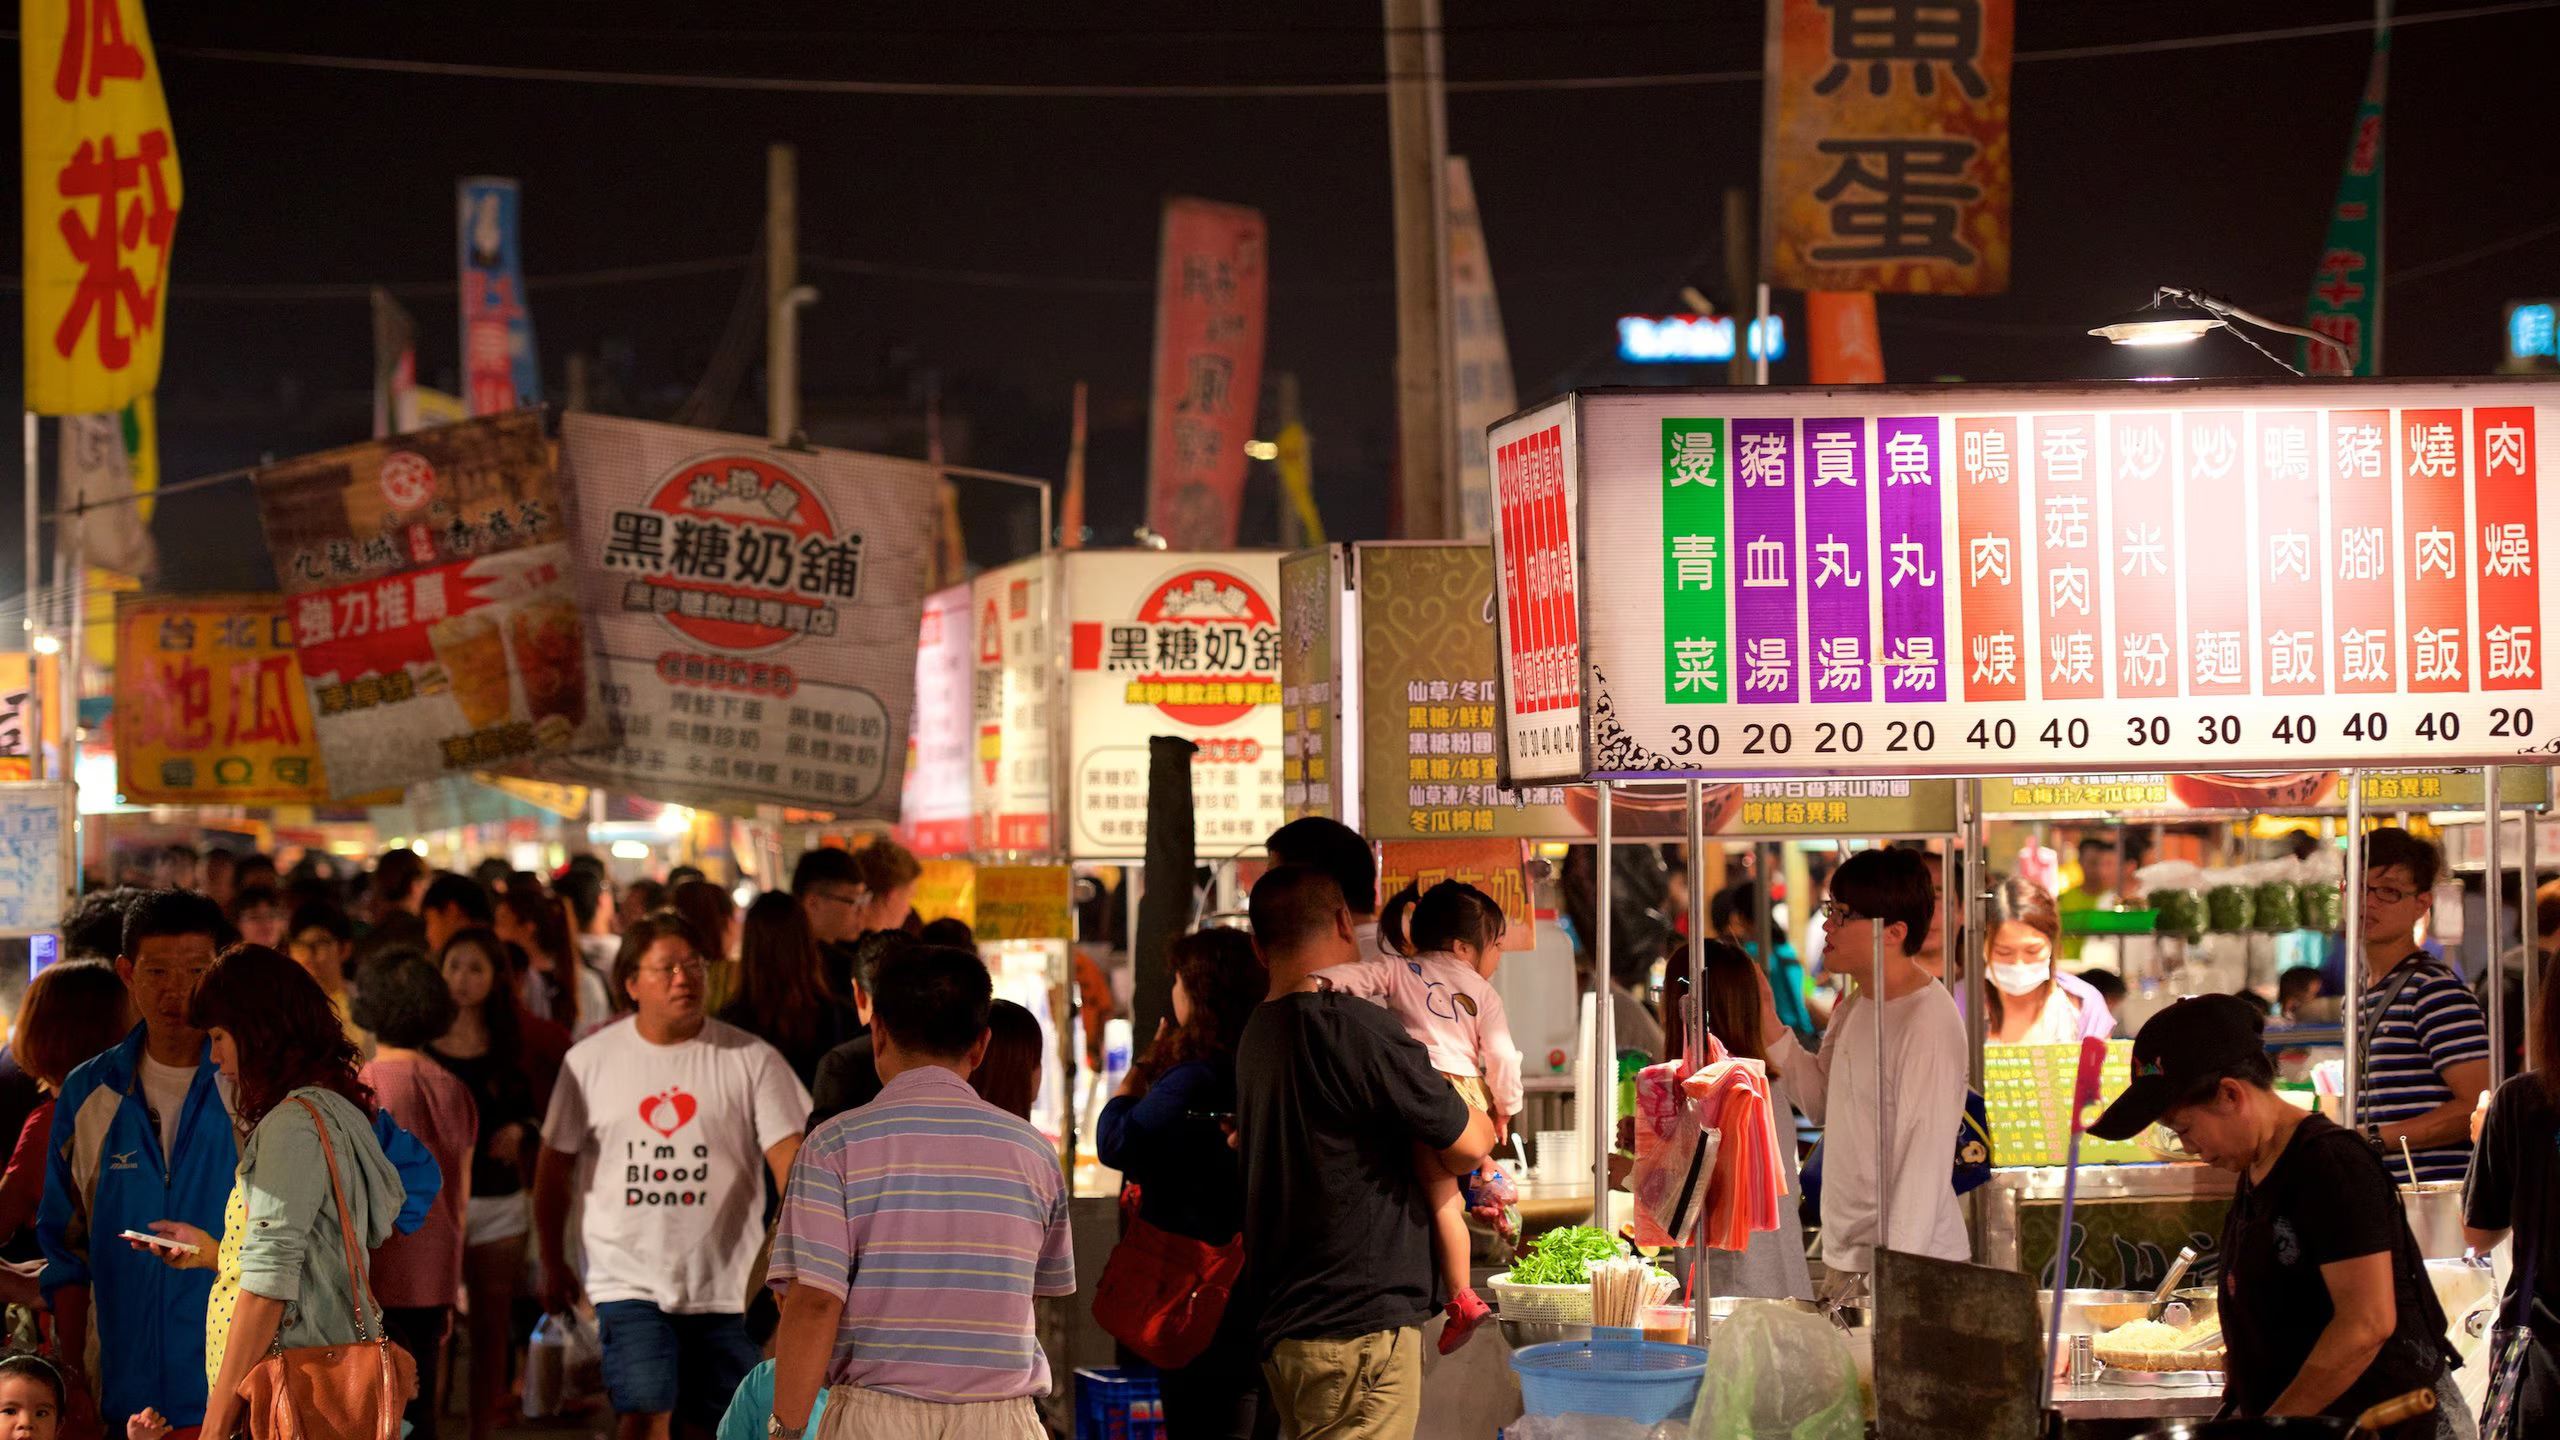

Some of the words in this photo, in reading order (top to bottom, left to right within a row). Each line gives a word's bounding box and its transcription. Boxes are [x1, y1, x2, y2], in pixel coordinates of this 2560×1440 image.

[1811, 0, 1987, 266] 魚蛋
[605, 512, 861, 597] 黑糖奶舖
[1670, 431, 1719, 692] 燙青菜
[1740, 431, 1791, 692] 豬血湯
[1812, 432, 1864, 692] 貢丸湯
[1885, 430, 1939, 691] 魚丸湯
[2118, 425, 2169, 687] 炒米粉
[2191, 425, 2241, 684] 炒麵
[2265, 426, 2316, 684] 鴨肉飯
[2336, 425, 2390, 683] 豬腳飯
[2409, 422, 2462, 682] 燒肉飯
[2484, 421, 2535, 680] 肉燥飯
[1409, 732, 1496, 755] 黑糖粉圓
[1671, 725, 1720, 755] 30
[1742, 724, 1792, 754] 20
[1814, 722, 1864, 753] 20
[1886, 721, 1935, 752] 20
[1967, 718, 2016, 749] 40
[2040, 718, 2089, 749] 40
[2127, 716, 2170, 746] 30
[2198, 715, 2241, 746] 30
[2272, 714, 2316, 745] 40
[2343, 713, 2387, 743] 40
[2415, 711, 2460, 741] 40
[2489, 708, 2533, 738] 20
[1743, 801, 1848, 824] 檸檬奇異果
[626, 1162, 708, 1183] Blood
[626, 1188, 707, 1207] Donor
[693, 1145, 708, 1159] a
